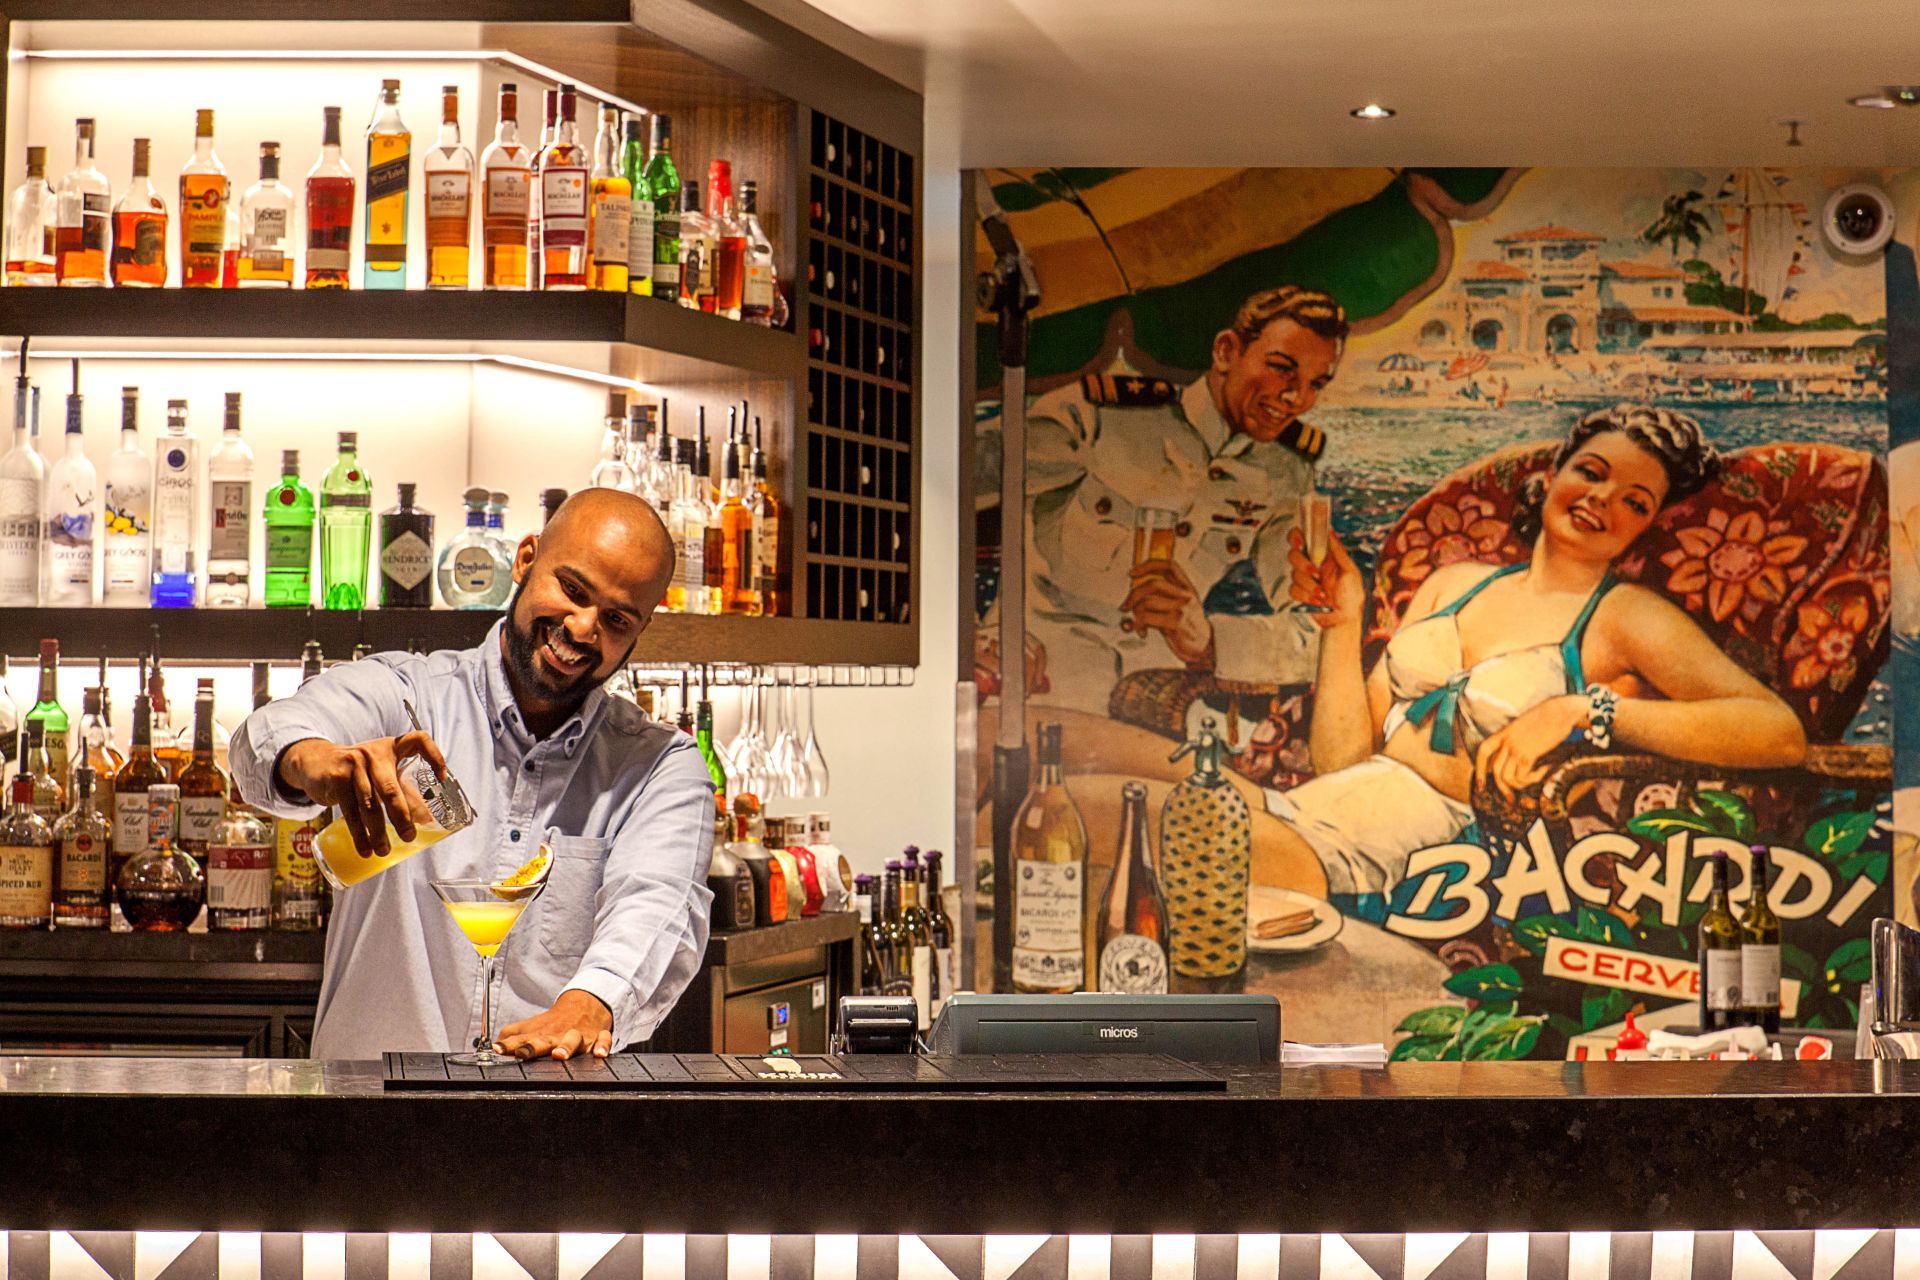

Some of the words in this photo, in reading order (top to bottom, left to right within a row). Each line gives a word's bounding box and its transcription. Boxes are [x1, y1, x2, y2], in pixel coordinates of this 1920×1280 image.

[55, 551, 76, 559] GREY
[66, 854, 101, 863] BACARDI
[1385, 817, 1878, 940] BACARDI
[1099, 1026, 1139, 1039] micros
